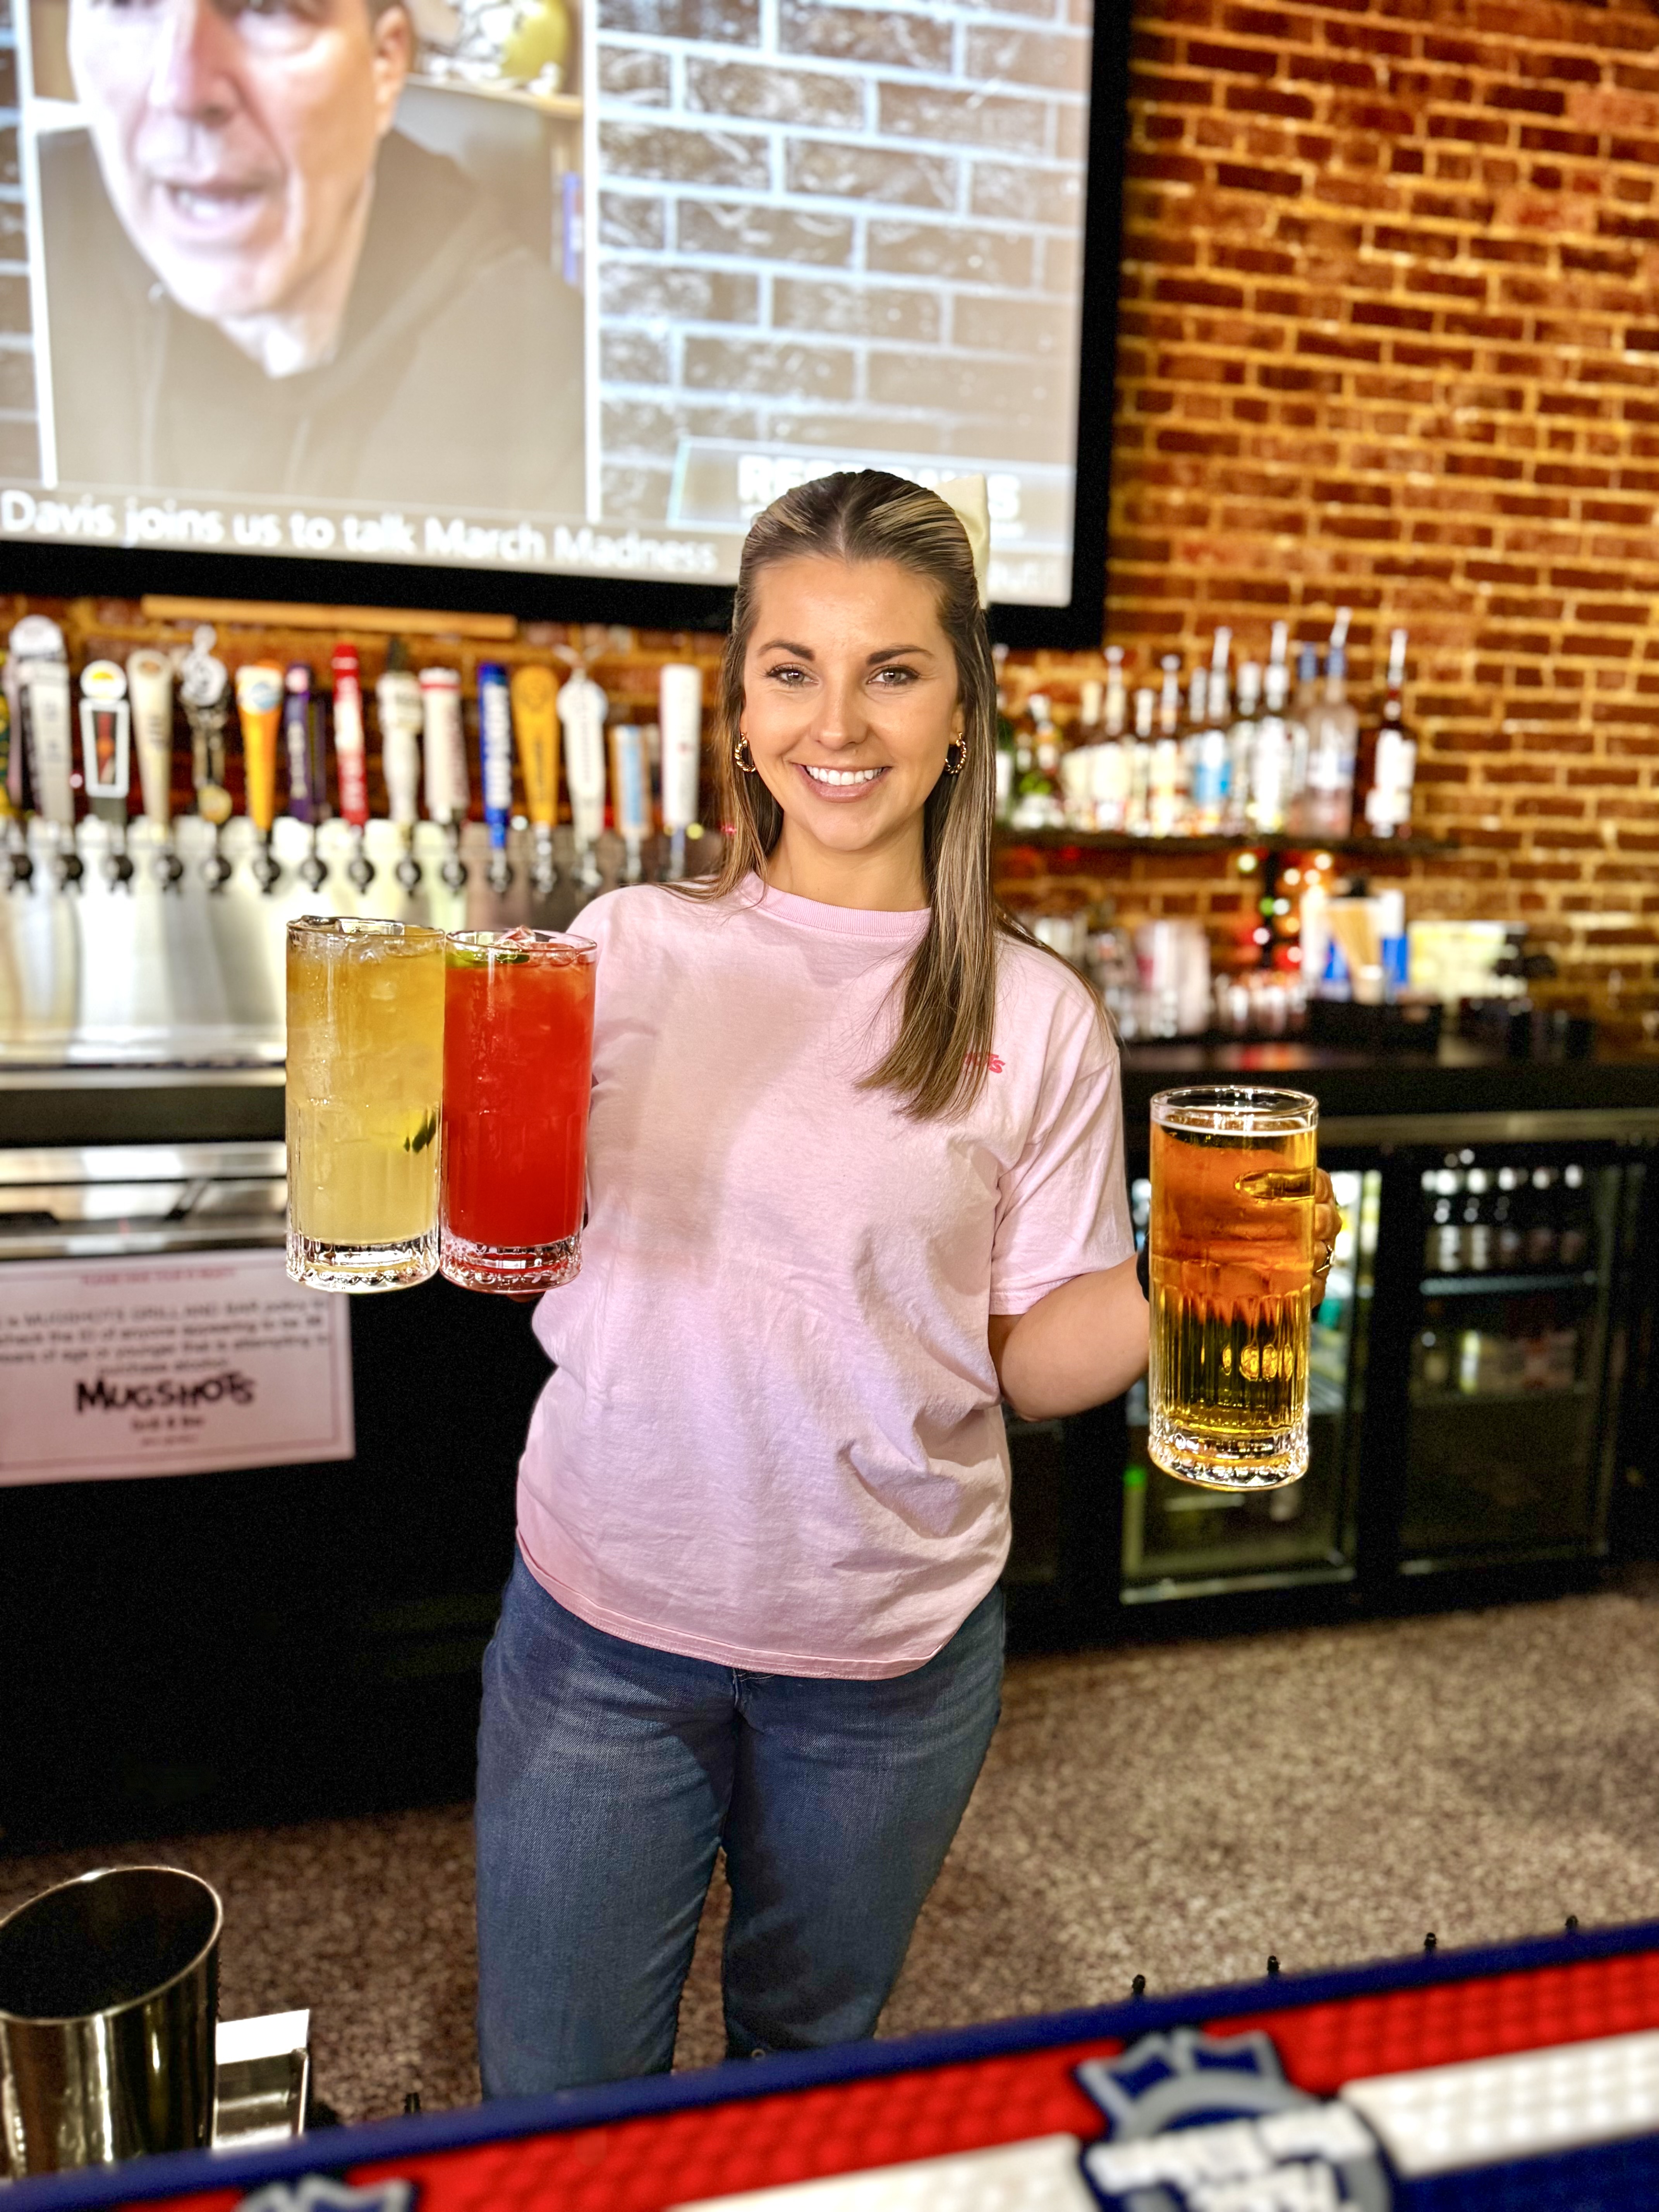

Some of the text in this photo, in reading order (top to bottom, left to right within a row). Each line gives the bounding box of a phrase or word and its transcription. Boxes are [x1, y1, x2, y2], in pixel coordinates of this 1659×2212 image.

[1, 489, 718, 574] Davis joins us to talk March Madness
[75, 1371, 255, 1413] MUGSHOTS
